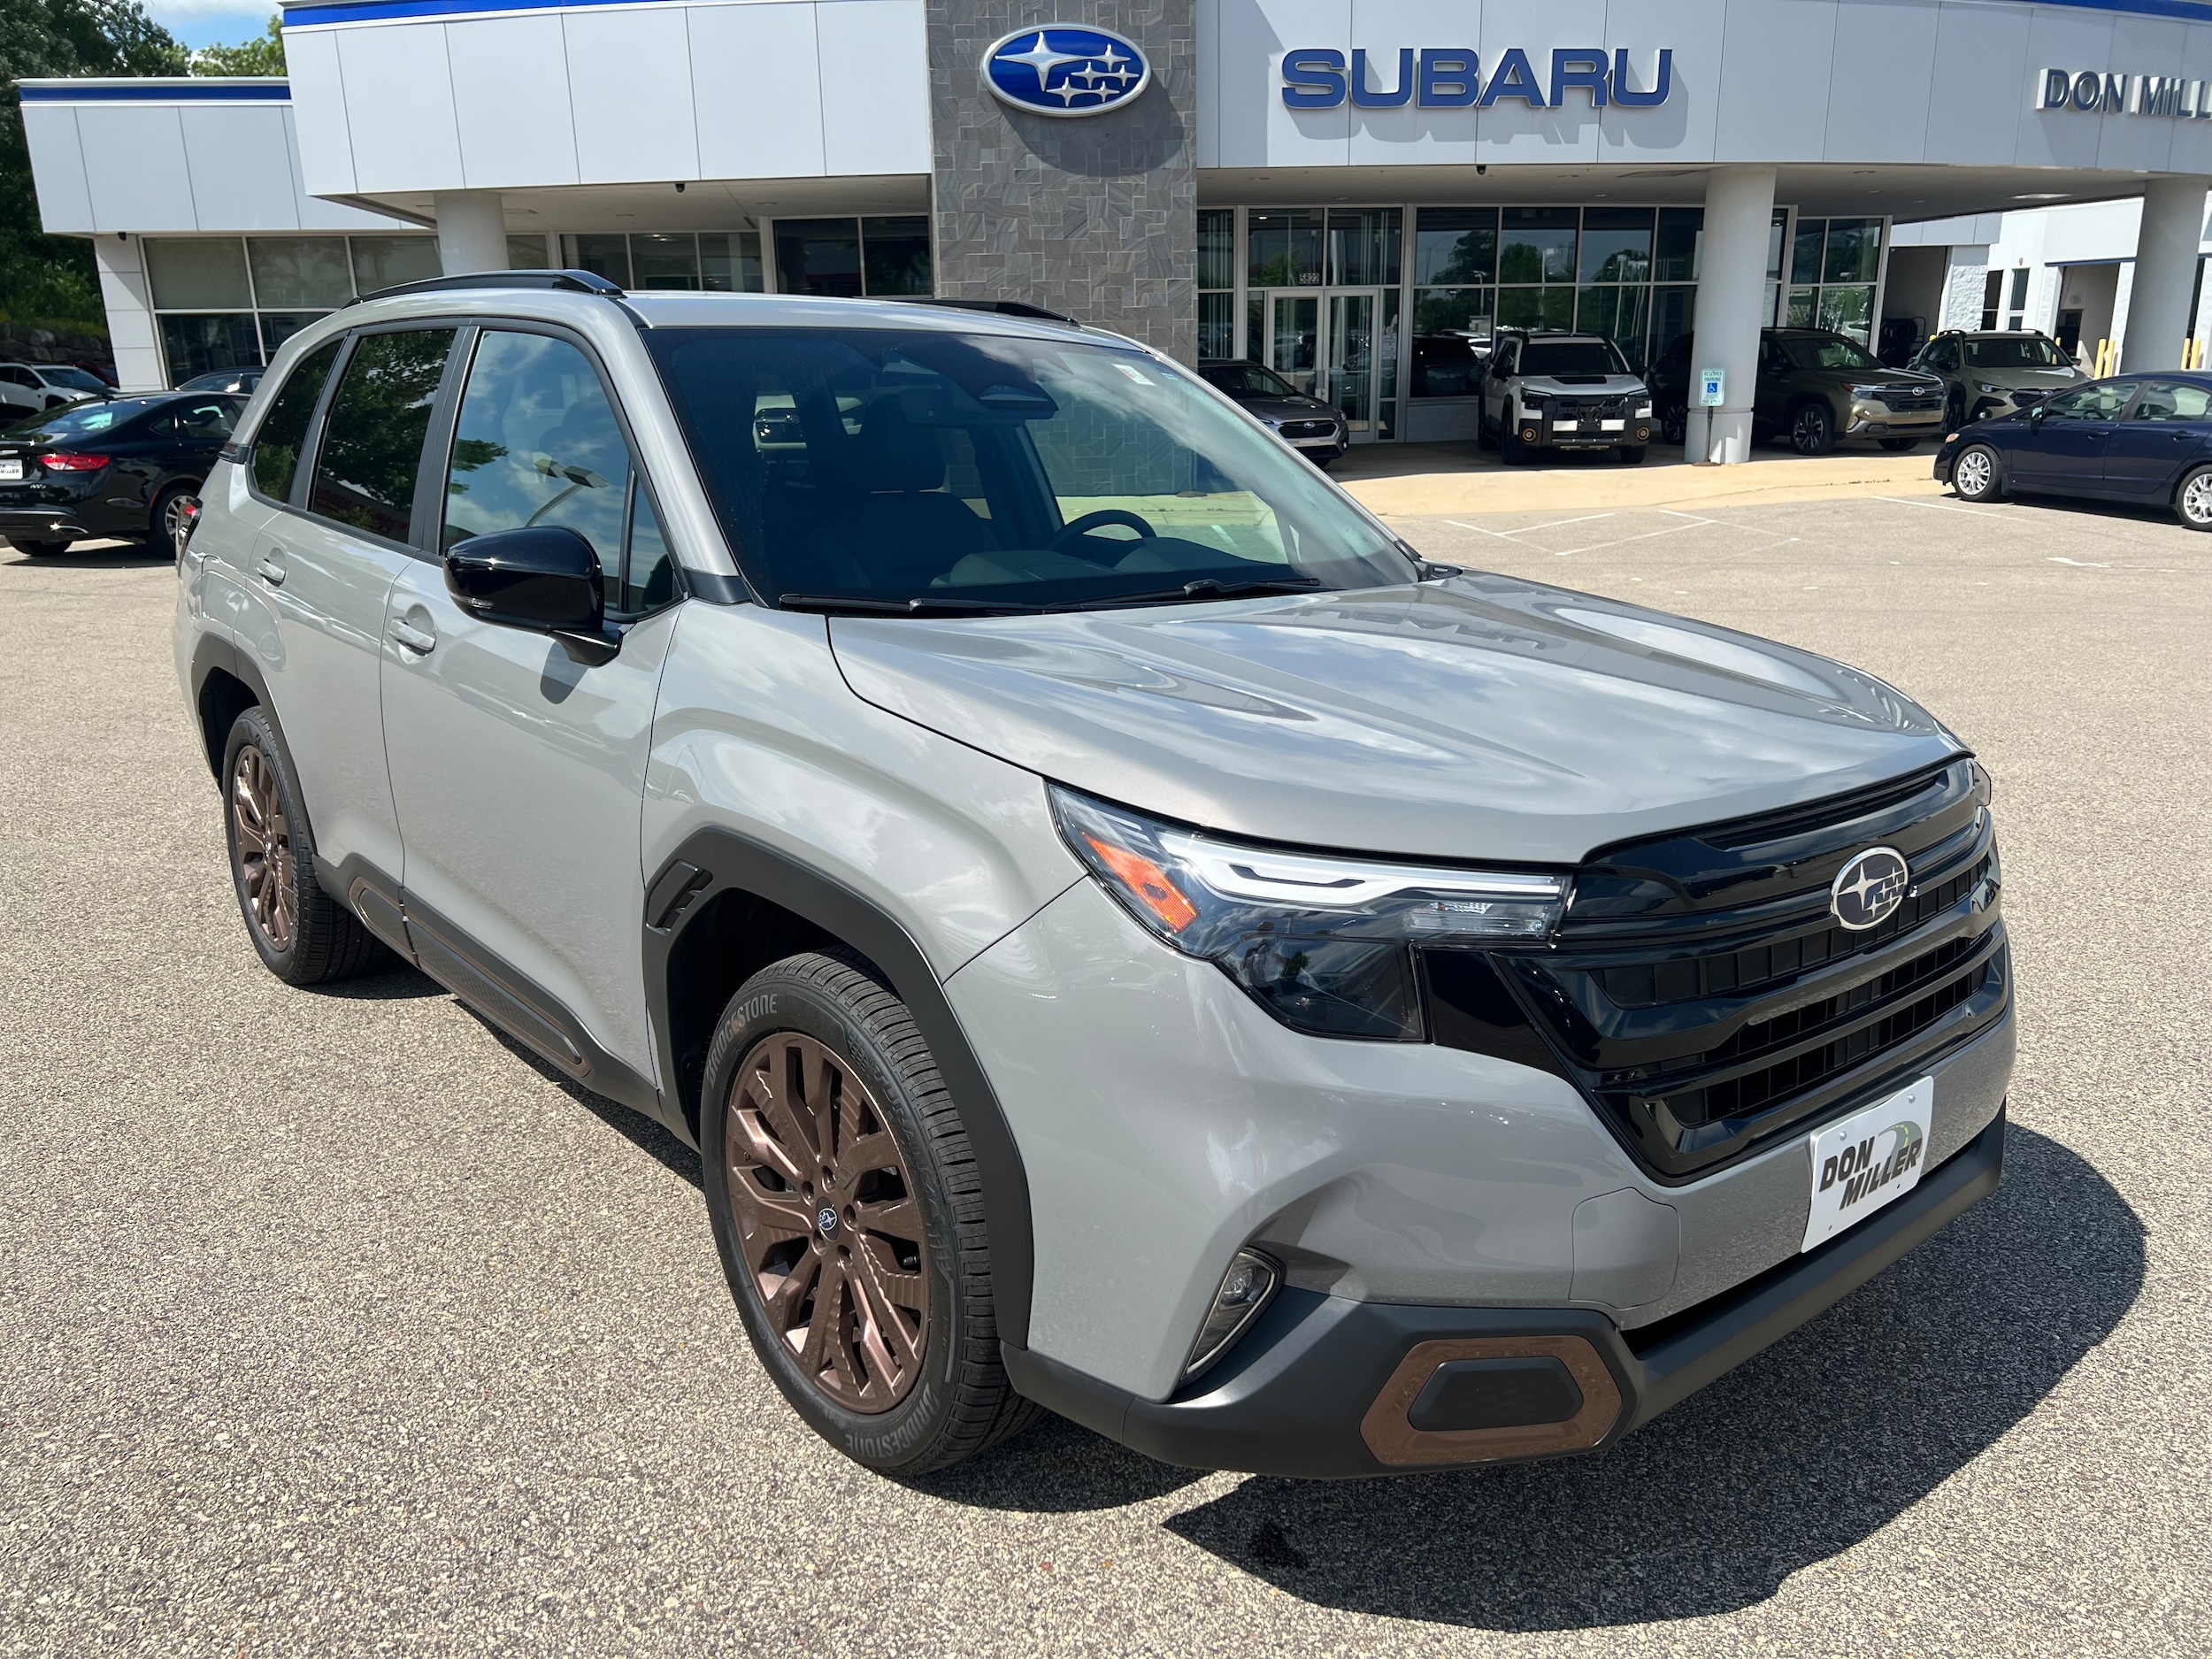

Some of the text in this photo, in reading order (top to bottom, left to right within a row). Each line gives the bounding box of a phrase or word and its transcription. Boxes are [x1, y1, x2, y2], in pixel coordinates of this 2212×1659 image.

[1281, 48, 1673, 107] SUBARU
[2037, 68, 2212, 119] DON MILL
[706, 993, 778, 1090] BRIDGESTONE
[1819, 1136, 1876, 1193] DON
[1839, 1138, 1923, 1210] MILLER
[845, 1382, 941, 1458] BRIDGESTONE
